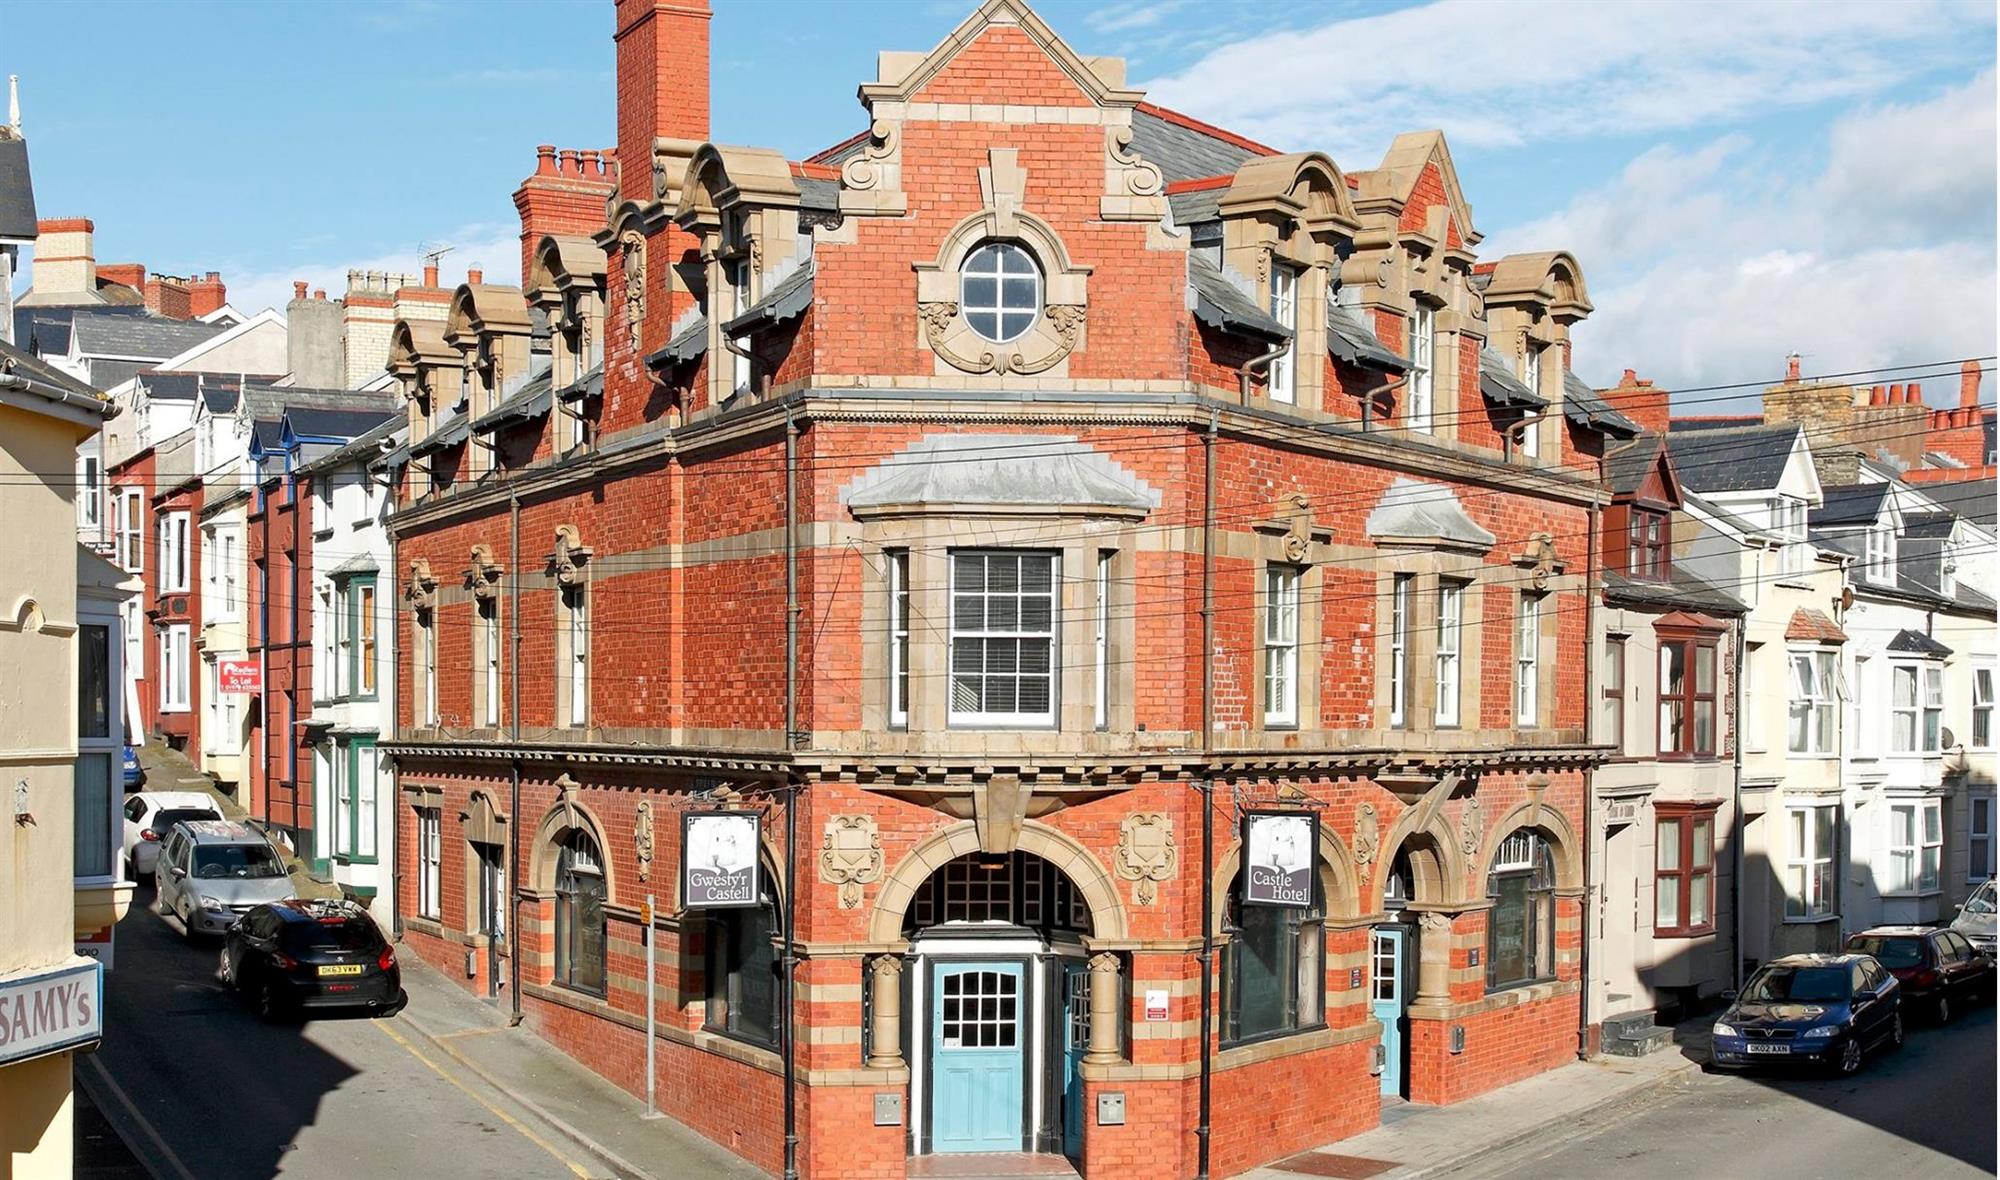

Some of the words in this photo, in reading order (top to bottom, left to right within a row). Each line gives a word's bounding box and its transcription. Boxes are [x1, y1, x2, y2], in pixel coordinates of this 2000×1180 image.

[230, 676, 239, 685] To
[240, 676, 252, 685] Let
[691, 872, 747, 890] Gwesty'r
[1253, 870, 1292, 887] Castle
[706, 886, 749, 900] Castell
[1272, 885, 1308, 901] Hotel
